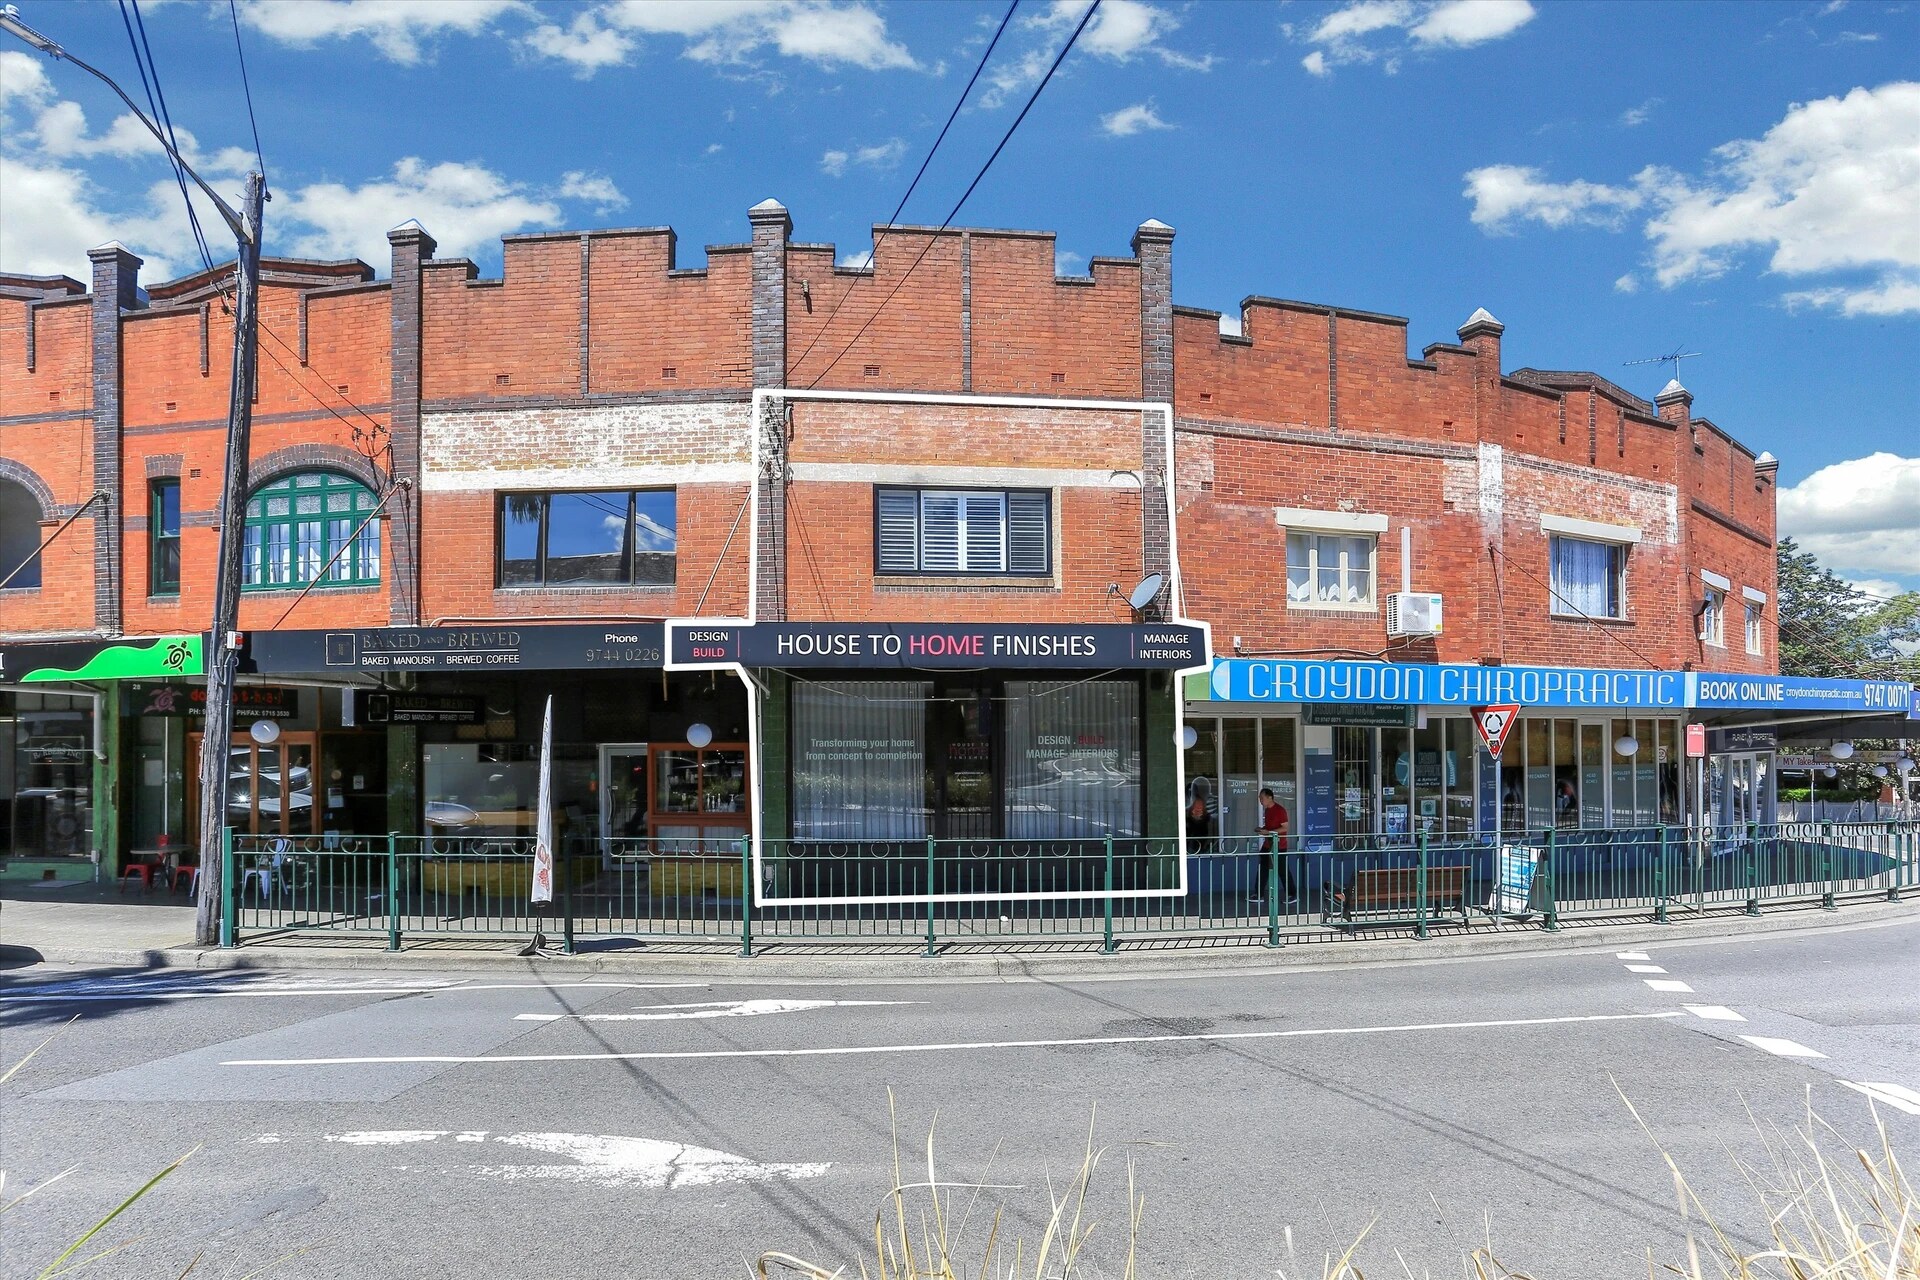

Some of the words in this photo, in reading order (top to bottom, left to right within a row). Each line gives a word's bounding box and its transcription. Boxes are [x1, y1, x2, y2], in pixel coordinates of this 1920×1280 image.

[362, 634, 420, 648] BAKED
[424, 636, 444, 644] AND
[448, 631, 521, 647] BREWED
[604, 633, 639, 643] Phone
[689, 631, 729, 641] DESIGN
[1143, 634, 1189, 644] MANAGE
[777, 634, 861, 655] HOUSE
[867, 634, 901, 655] TO
[910, 634, 985, 655] HOME
[992, 635, 1096, 656] FINISHES
[586, 649, 620, 661] 9744
[625, 648, 660, 661] 0226
[693, 647, 725, 657] BUILD
[1139, 649, 1192, 659] INTERIORS
[362, 656, 390, 665] BAKED
[393, 656, 434, 665] MANOUSH
[446, 655, 483, 664] BREWED
[486, 654, 520, 663] COFFEE
[1248, 664, 1424, 700] CROYDON
[1441, 669, 1674, 704] CHIROPRACTIC
[1700, 681, 1738, 700] BOOK
[1740, 682, 1784, 701] ONLINE
[1785, 686, 1863, 699] croydonchiropractic.com.au
[1864, 684, 1885, 707] 9747
[1887, 685, 1909, 708] 0071
[810, 738, 868, 749] Transforming
[870, 739, 889, 749] your
[891, 738, 915, 747] home
[1037, 736, 1071, 745] DESIGN
[1078, 736, 1105, 745] BUILD
[806, 752, 826, 760] from
[828, 752, 862, 761] concept
[864, 752, 873, 760] to
[875, 751, 923, 761] completion
[1026, 749, 1065, 759] MANAGE
[1071, 749, 1119, 759] INTERIORS
[1783, 757, 1795, 766] MY
